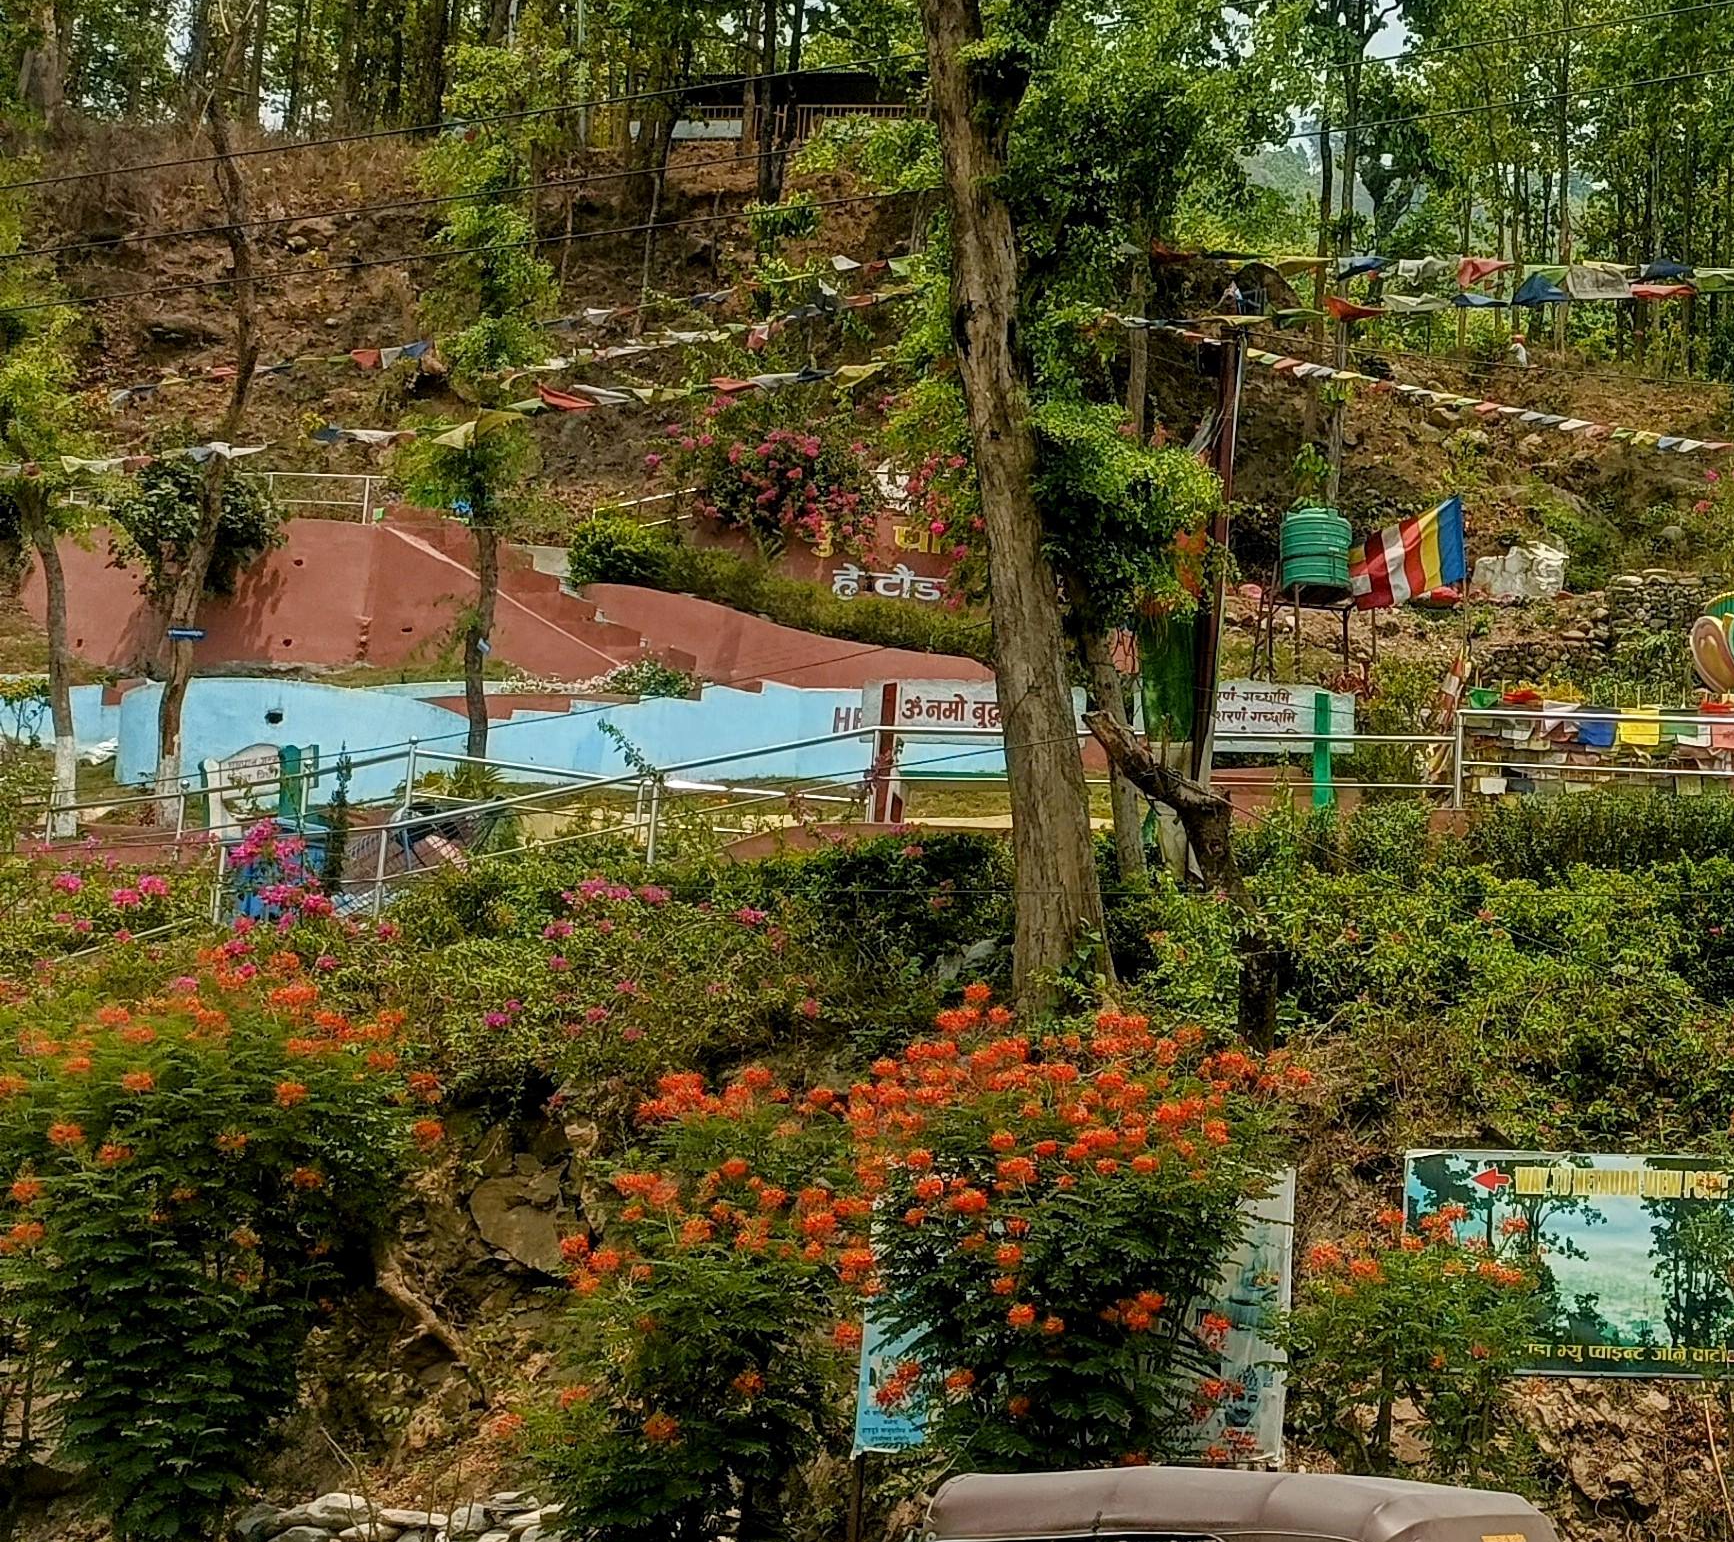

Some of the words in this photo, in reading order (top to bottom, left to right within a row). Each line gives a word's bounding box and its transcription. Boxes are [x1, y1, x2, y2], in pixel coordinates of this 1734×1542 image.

[832, 562, 947, 601] हेटौंड
[926, 693, 968, 722] नमो
[1216, 685, 1237, 702] रणं
[1515, 1167, 1549, 1195] WAY
[1550, 1167, 1572, 1196] TO
[1643, 1169, 1683, 1198] VIEW
